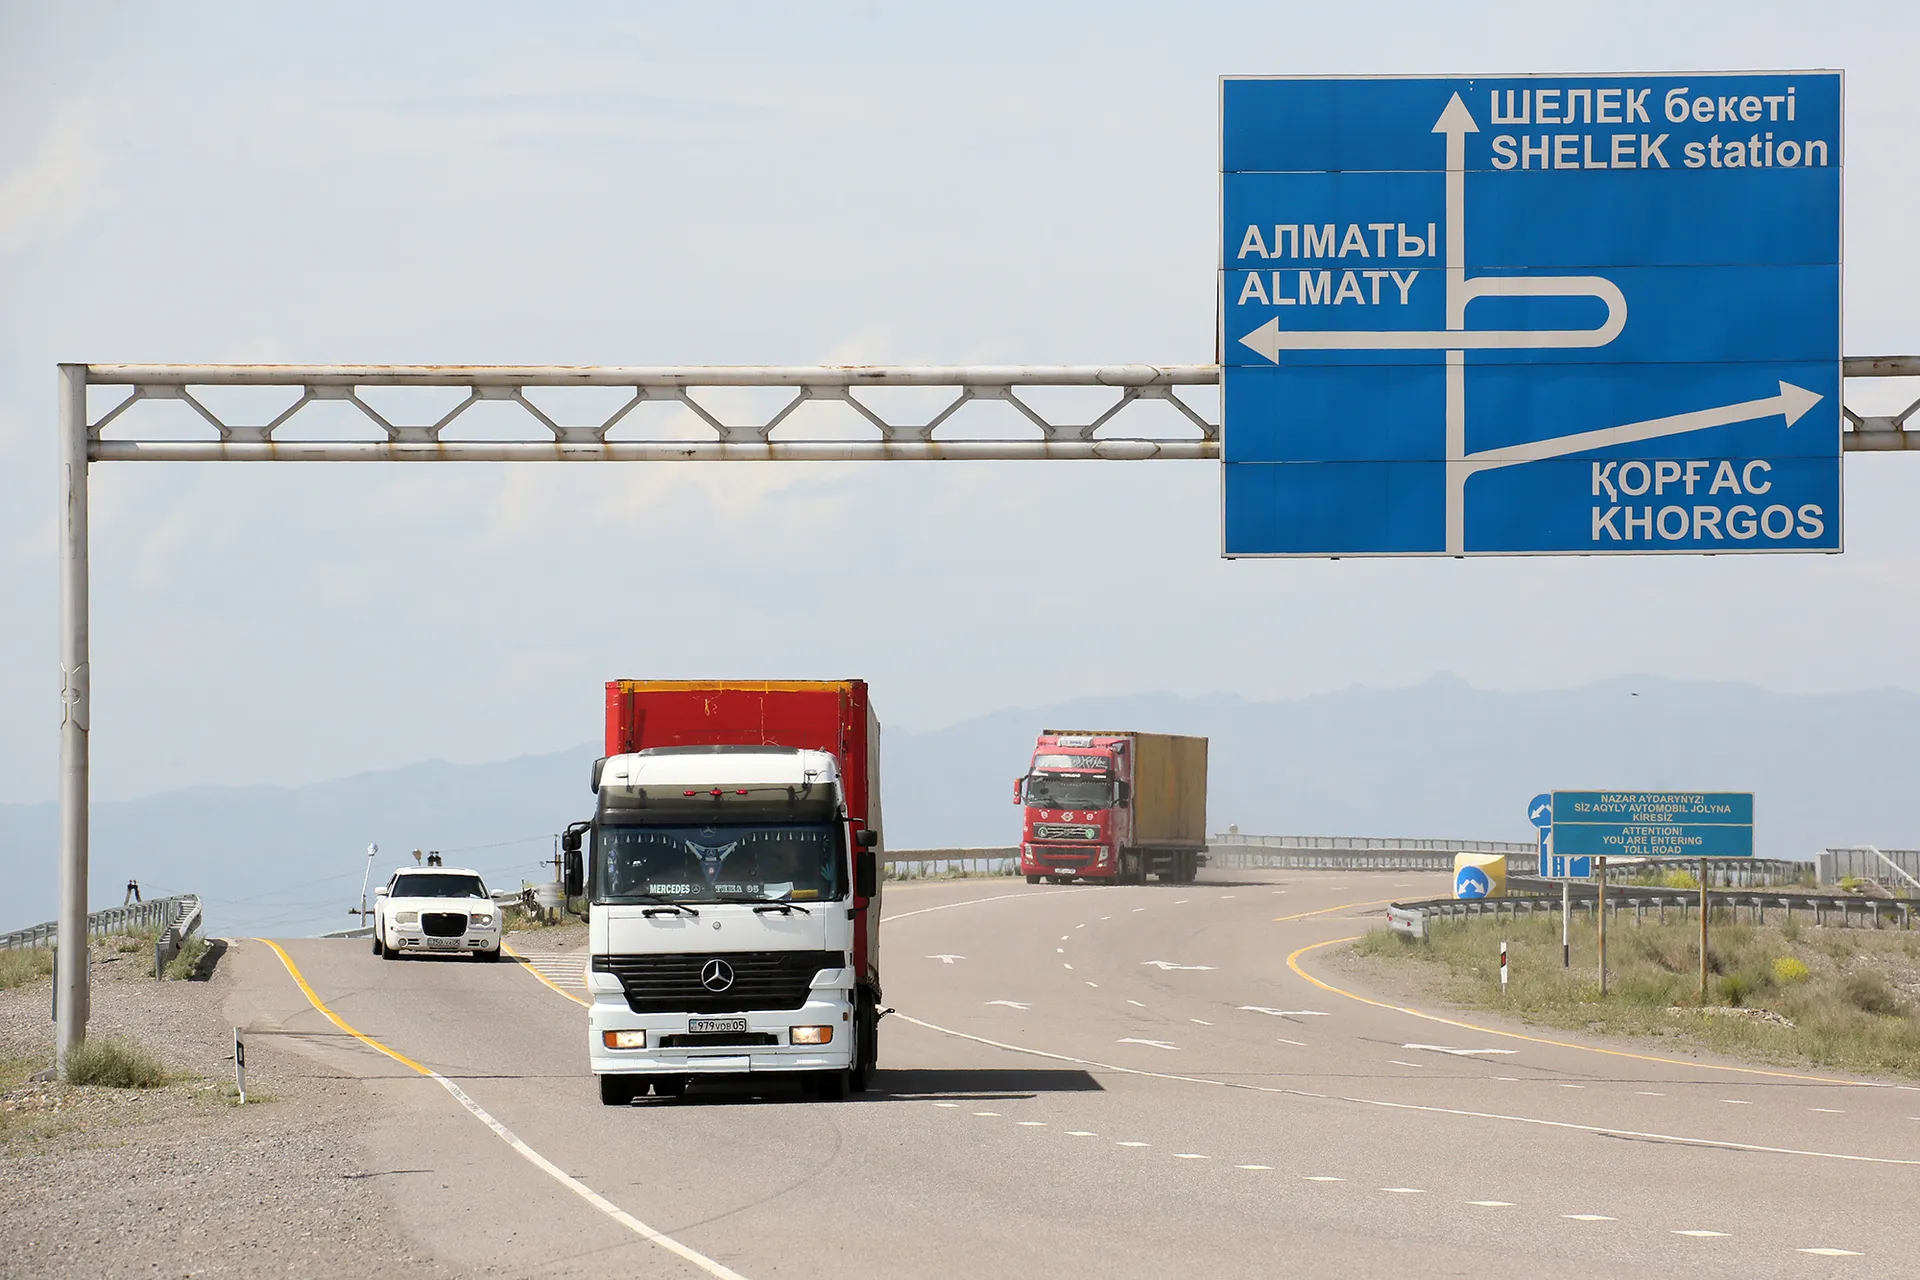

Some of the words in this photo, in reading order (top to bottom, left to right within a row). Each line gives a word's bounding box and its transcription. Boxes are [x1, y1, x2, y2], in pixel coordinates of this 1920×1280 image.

[1491, 88, 1651, 124] ШЕЛЕК
[1664, 86, 1796, 123] бекеті
[1491, 133, 1671, 170] SHELEK
[1683, 132, 1828, 168] station
[1237, 222, 1436, 259] АЛМАТЫ
[1237, 268, 1420, 306] ALMATY
[1592, 459, 1772, 503] ҚОРҒАС
[1592, 504, 1825, 541] KHORGOS
[1593, 804, 1626, 813] AQYLY
[1690, 804, 1731, 813] JOLYNA
[1601, 794, 1636, 803] NAZAR
[1602, 836, 1624, 845] YOU
[1626, 836, 1648, 845] ARE
[1651, 836, 1703, 845] ENTERING
[1622, 827, 1683, 836] ATTENTION!
[1623, 845, 1650, 854] TOLL
[1652, 845, 1682, 854] ROAD
[649, 884, 691, 894] MERCEDES
